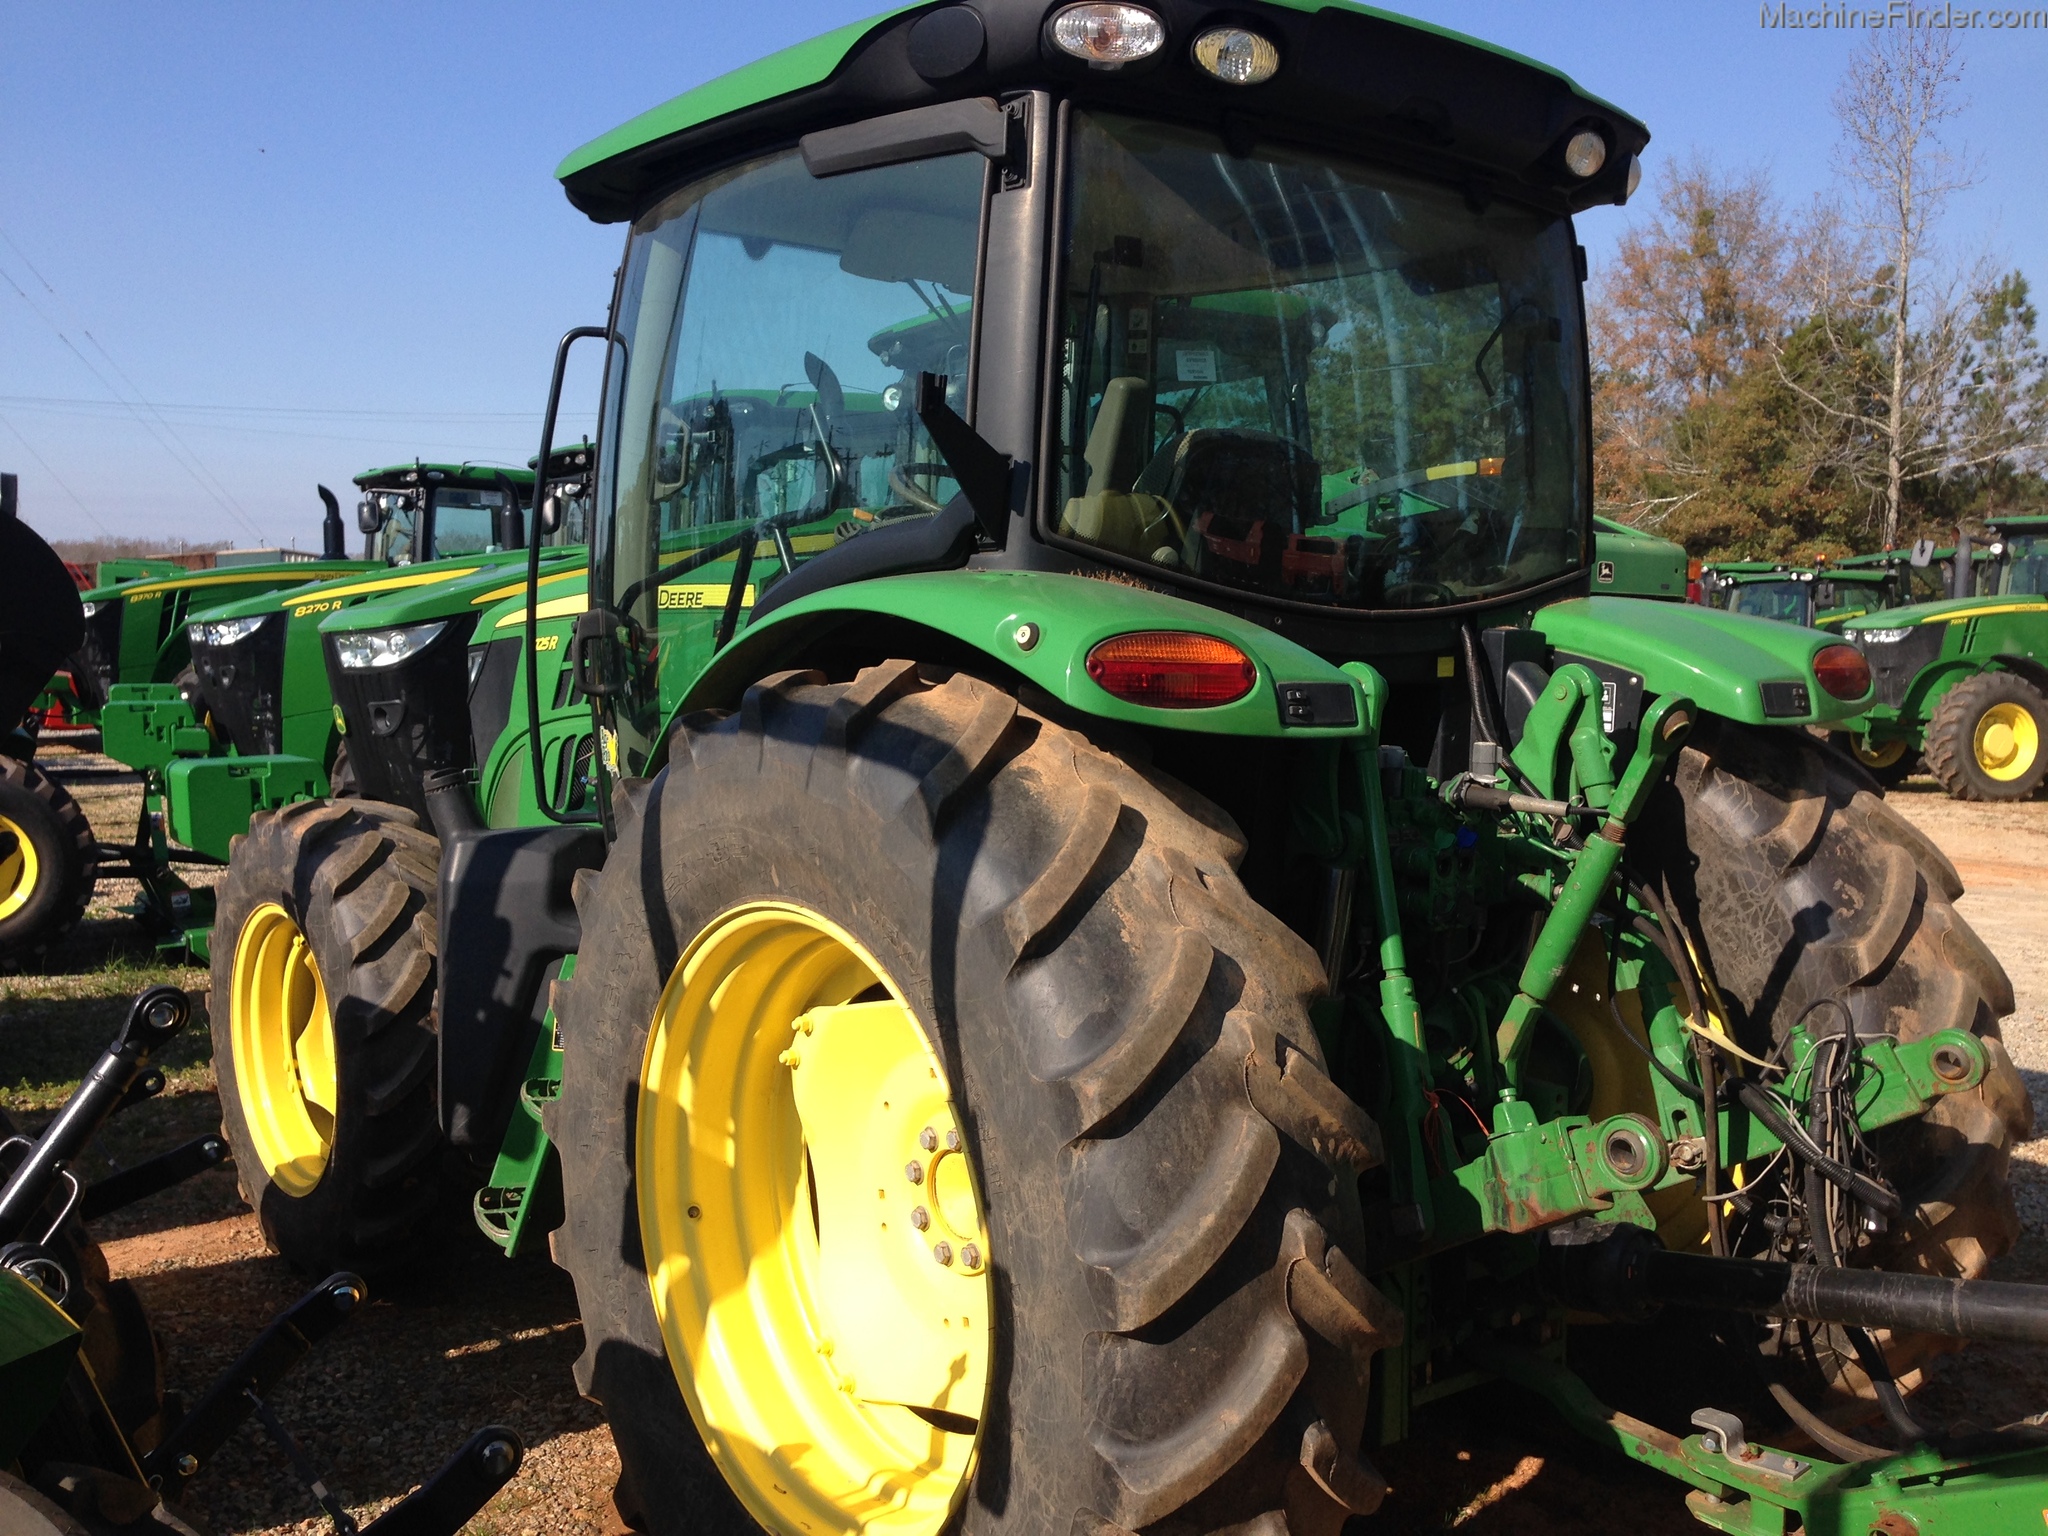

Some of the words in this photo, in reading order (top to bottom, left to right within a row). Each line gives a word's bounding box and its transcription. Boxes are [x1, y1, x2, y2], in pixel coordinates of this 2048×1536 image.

[659, 590, 704, 606] DEERE
[294, 602, 330, 618] 8270
[331, 600, 342, 610] R
